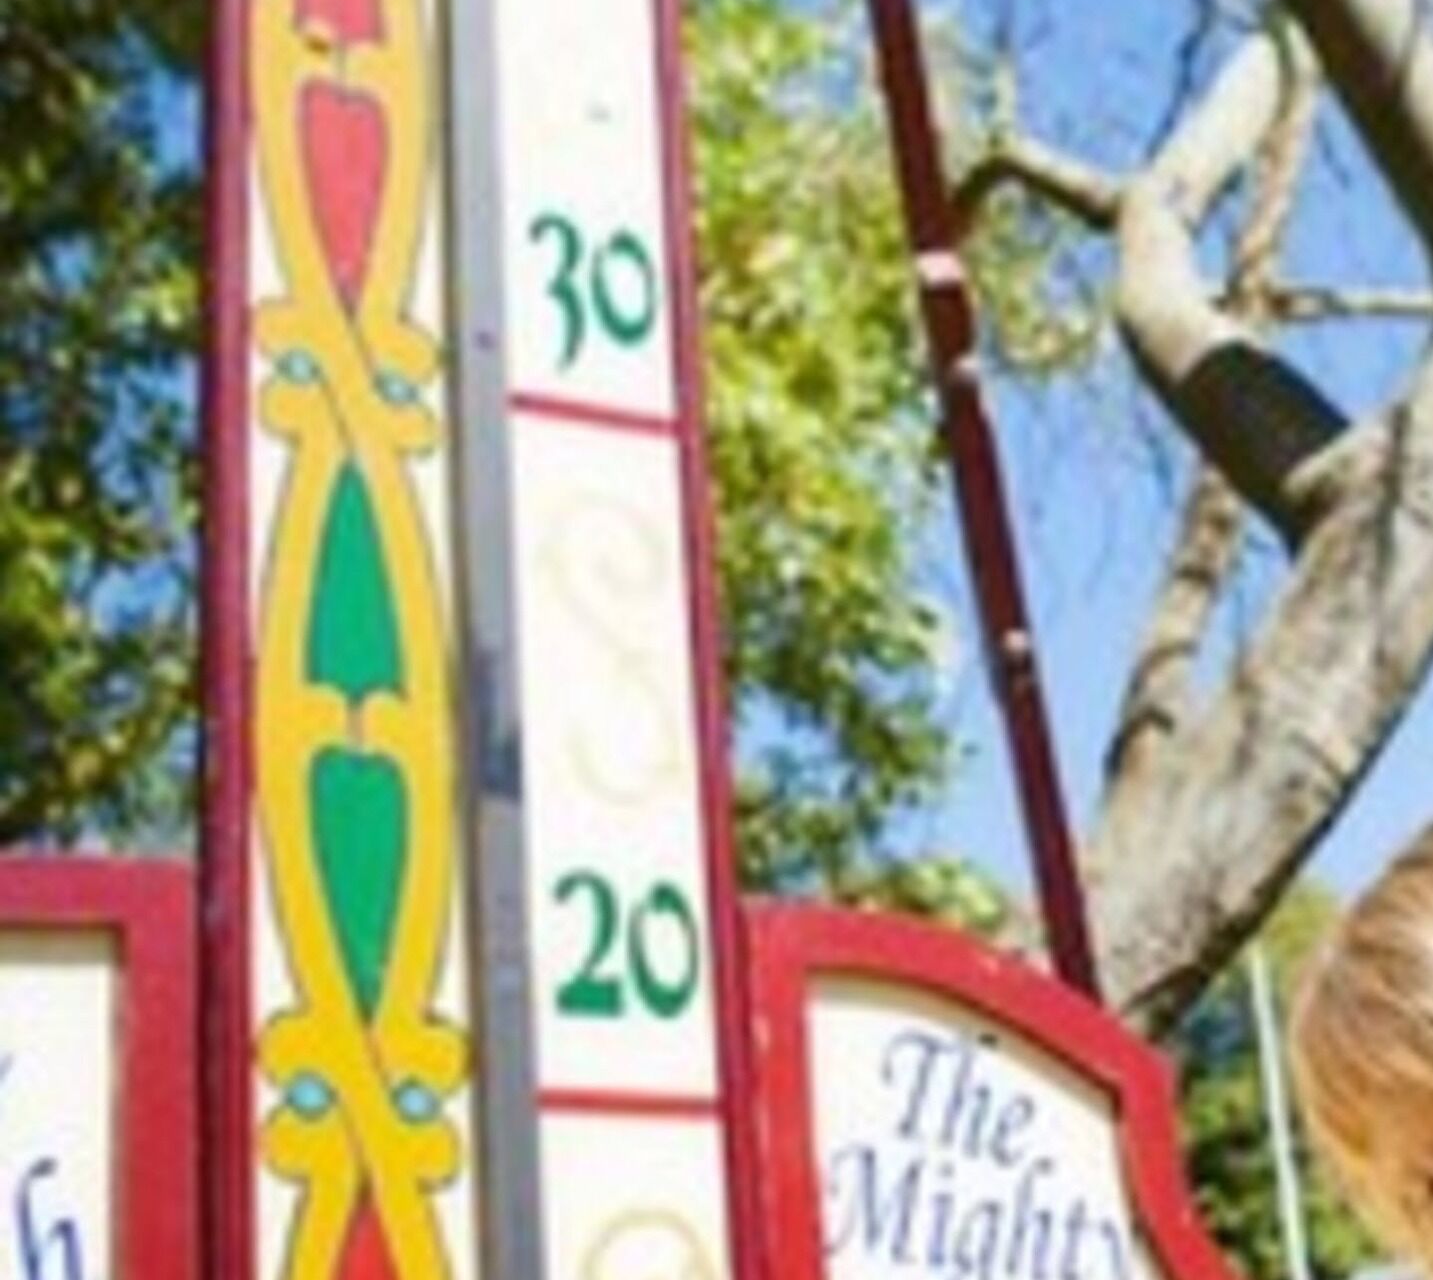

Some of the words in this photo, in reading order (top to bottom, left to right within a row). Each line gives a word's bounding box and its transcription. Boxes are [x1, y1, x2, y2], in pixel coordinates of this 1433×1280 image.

[528, 212, 658, 372] 30
[552, 871, 700, 1019] 20
[880, 1029, 1035, 1169] The
